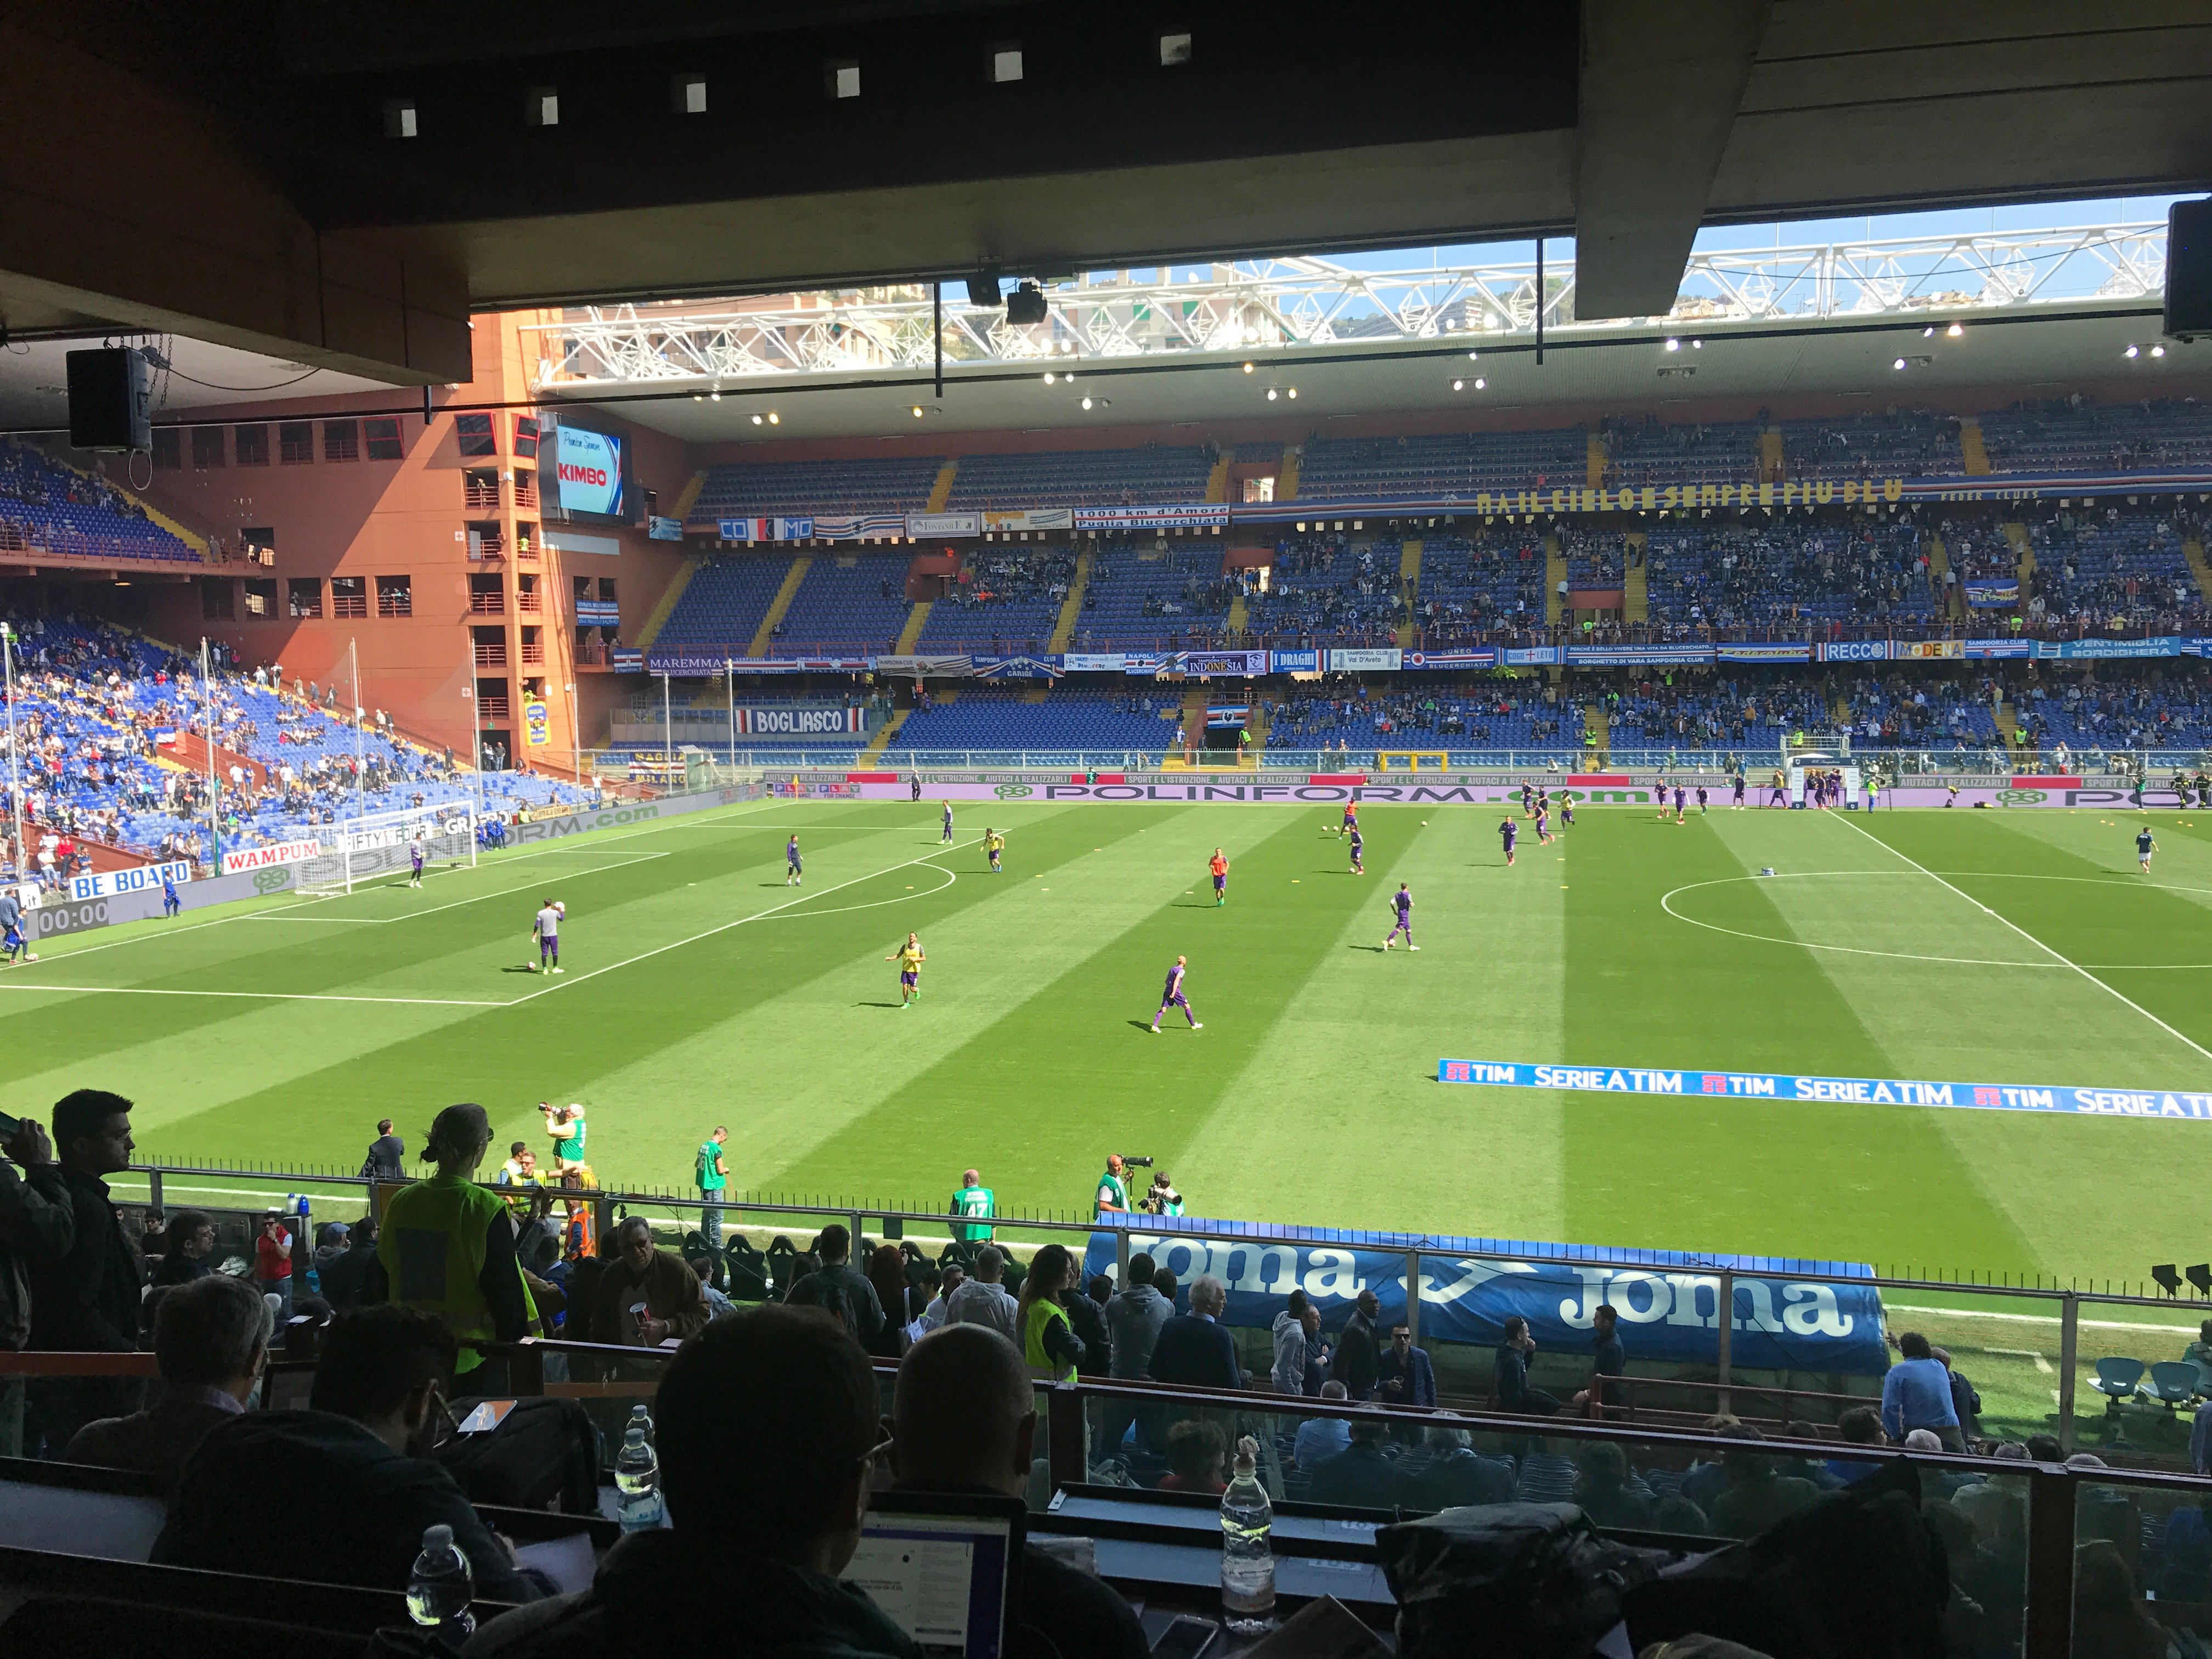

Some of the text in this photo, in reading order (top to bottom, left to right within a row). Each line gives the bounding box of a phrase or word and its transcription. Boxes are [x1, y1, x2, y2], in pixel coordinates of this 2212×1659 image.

[558, 462, 606, 487] KIMBO
[1664, 482, 1773, 509] SEMPRE
[1158, 507, 1227, 515] d'Amore
[1131, 517, 1226, 526] Blucerchiata
[2074, 638, 2170, 647] VENTIMIGLIA
[1537, 651, 1553, 659] LETO
[1829, 642, 1884, 659] RECCO
[1900, 643, 1961, 657] MODENA
[2072, 648, 2171, 657] BORDIGHERA
[650, 658, 722, 668] MAREMMA
[1274, 653, 1314, 666] I DRAGHI
[1189, 662, 1243, 672] INDONESIA
[757, 710, 842, 732] BOGLIASCO
[636, 775, 686, 784] MILANO
[1128, 775, 1305, 785] SPORT E L'ISTRUZIONE. AIUTACI A REALIZZARLI
[1371, 775, 1565, 785] SPORT E L'ISTRUZIONE. AIUTACI A REALIZZARLI
[1901, 778, 1935, 787] AIUTACI
[1948, 778, 2008, 788] REALIZZARLI
[2087, 779, 2120, 787] SPORT
[820, 785, 860, 793] PLAY
[1046, 786, 1650, 802] POLINFORM.com
[2066, 791, 2212, 806] PO
[228, 842, 319, 871] WAMPUM
[75, 862, 188, 899] BE BOARD
[39, 902, 108, 933] 00:00
[1472, 1064, 1515, 1083] TIM
[1629, 1070, 1682, 1093] TIM
[1729, 1076, 1775, 1095] TIM
[1894, 1082, 1954, 1105] TIM
[2002, 1088, 2053, 1108] TIM
[967, 1203, 988, 1218] 47
[1559, 1267, 1853, 1338] Joma
